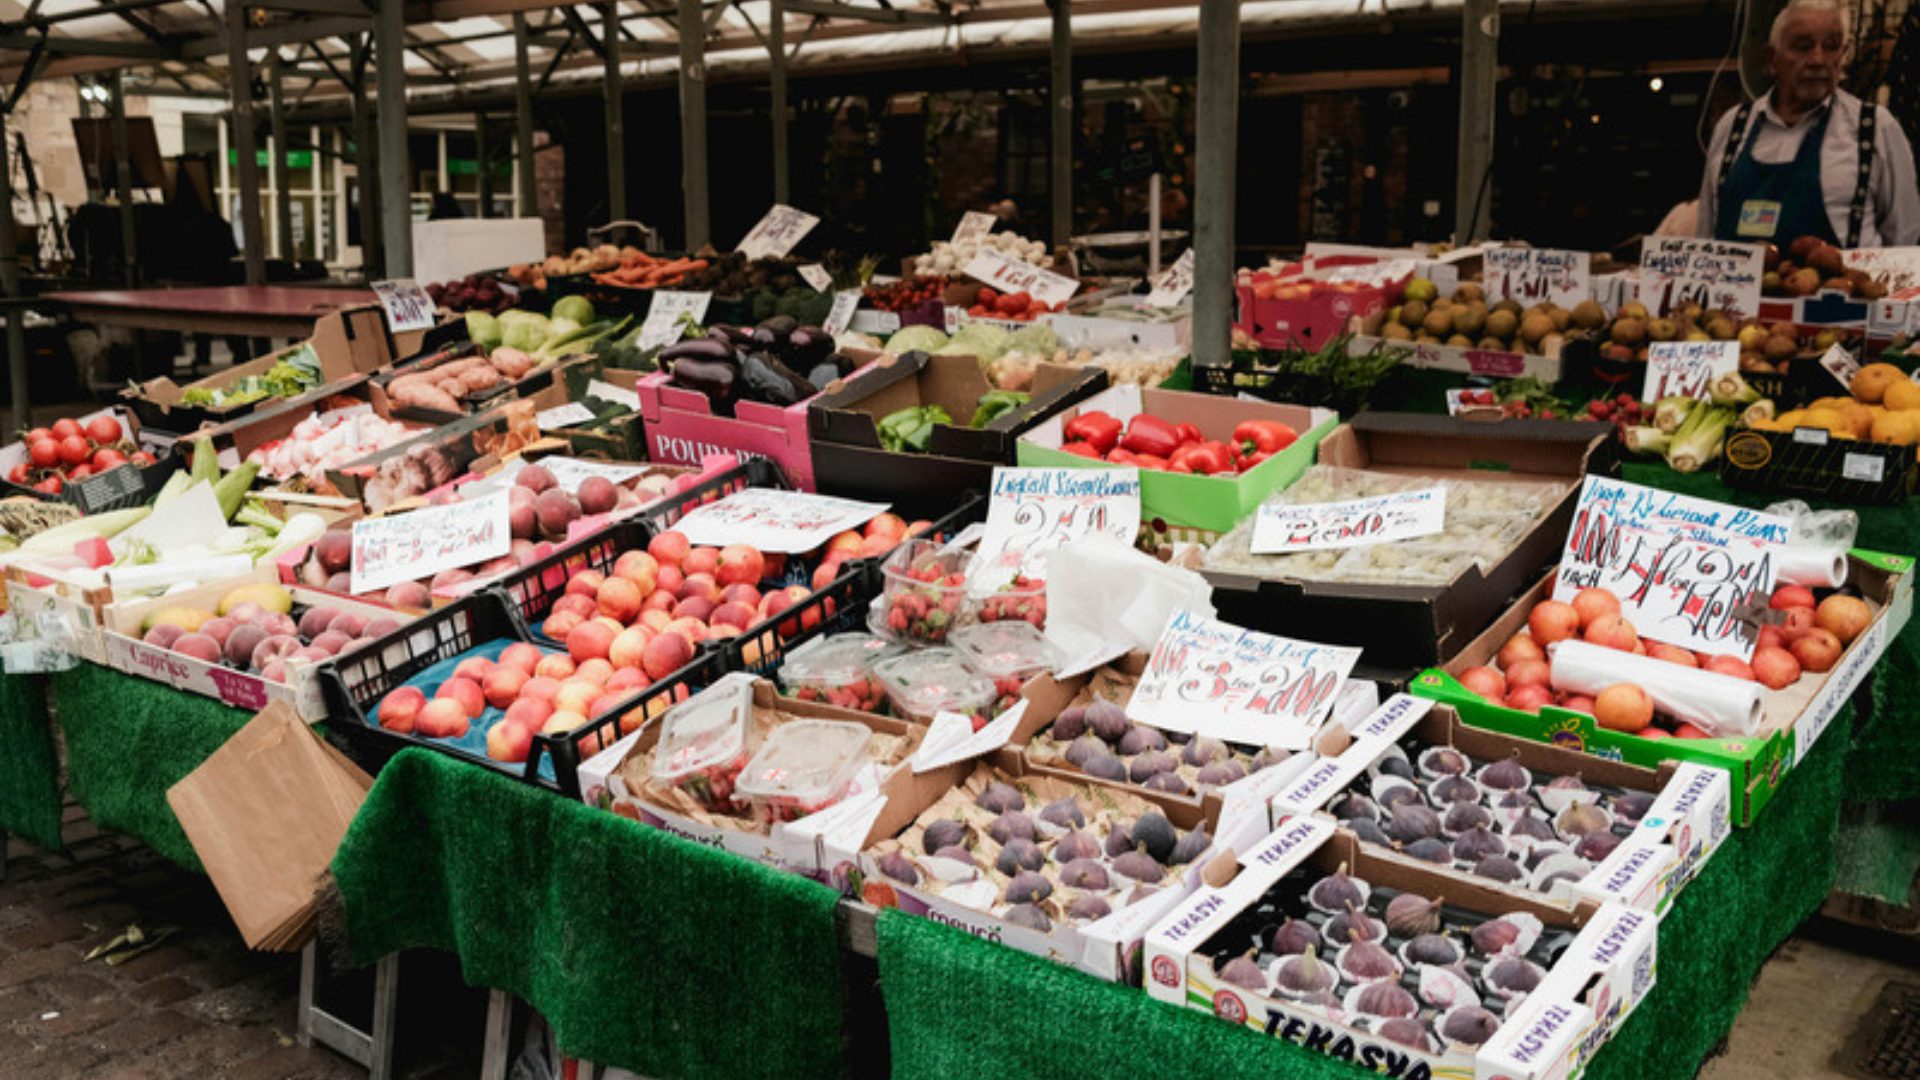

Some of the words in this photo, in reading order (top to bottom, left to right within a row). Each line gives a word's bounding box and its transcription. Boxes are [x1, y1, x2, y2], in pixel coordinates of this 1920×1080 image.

[128, 644, 190, 680] Caprice
[1366, 699, 1414, 738] TEKASYA
[1288, 762, 1339, 804] TEKASYA
[1674, 769, 1718, 813] TEKASYA
[1257, 820, 1317, 866] TEKASYA
[1607, 848, 1656, 893] TEKASYA
[1163, 893, 1224, 942] TEKASYA
[1593, 911, 1644, 963] TEKASYA
[1262, 1008, 1432, 1080] TEKASYA
[1512, 1004, 1571, 1063] TEKASYA
